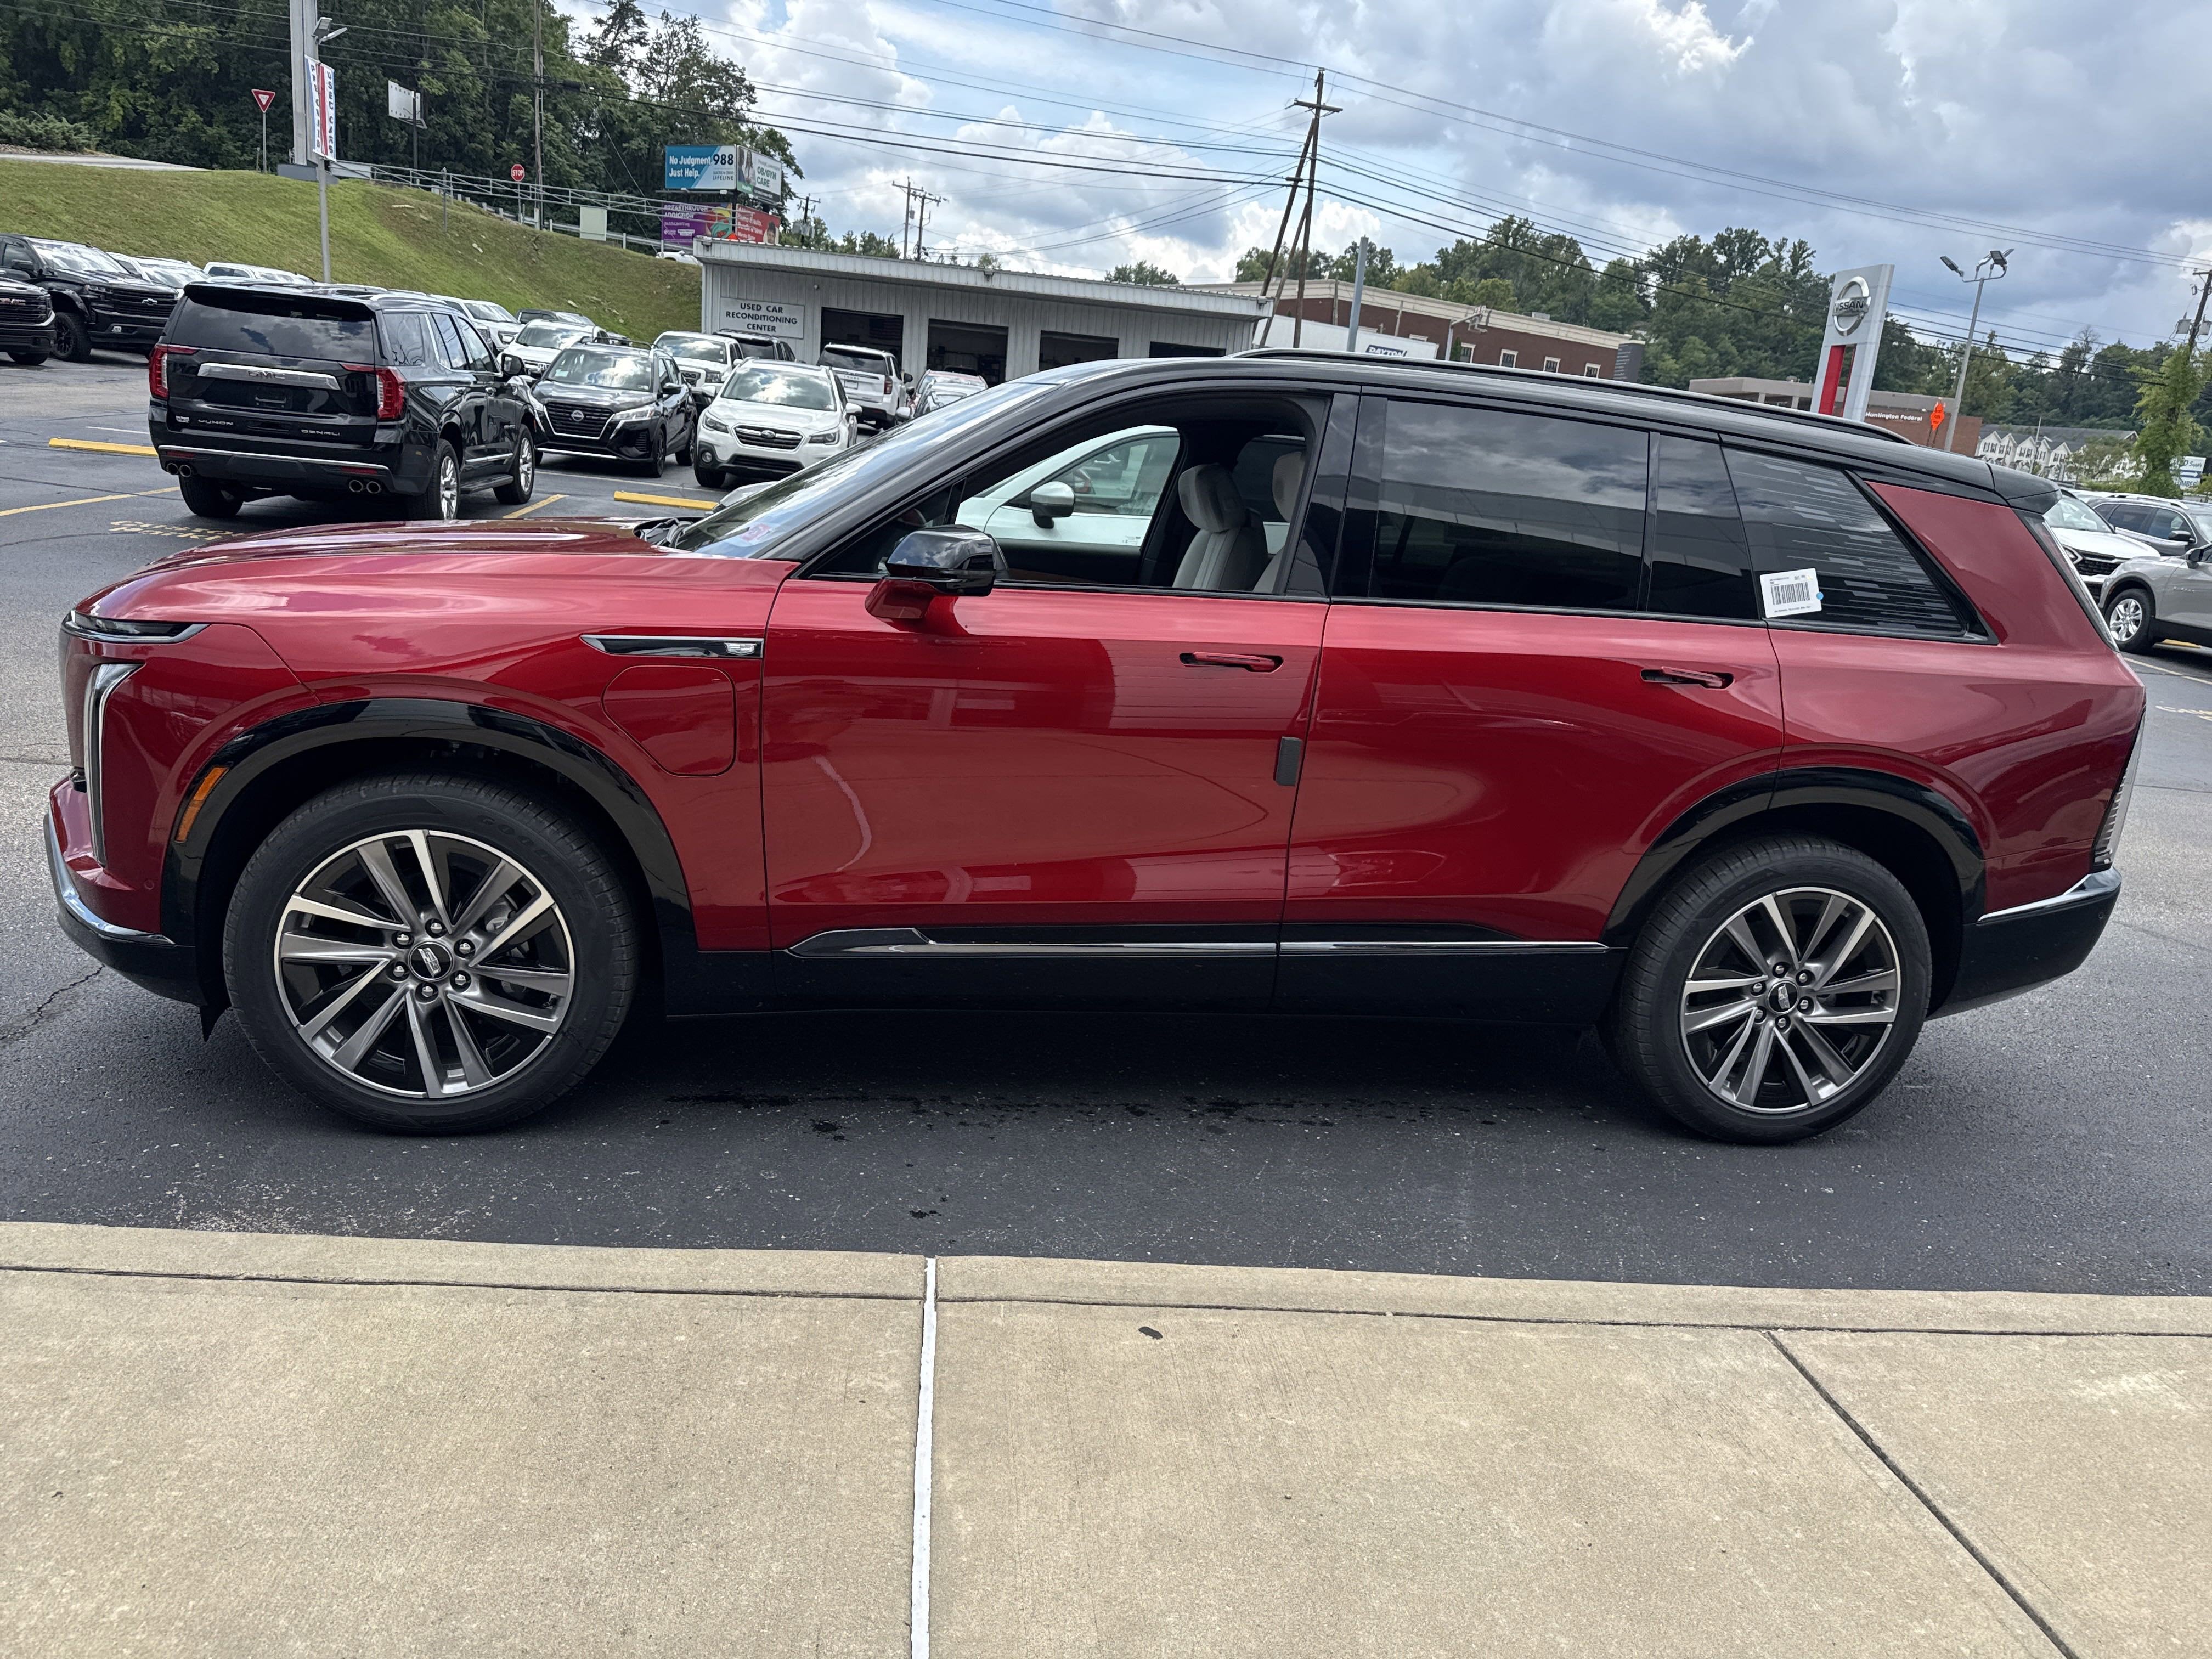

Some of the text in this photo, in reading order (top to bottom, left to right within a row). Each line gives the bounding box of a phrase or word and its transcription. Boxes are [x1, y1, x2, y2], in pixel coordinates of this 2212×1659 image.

[669, 156, 678, 165] No
[713, 154, 733, 165] 988
[669, 168, 700, 179] Just Help.
[757, 166, 776, 180] OB/GYN
[757, 176, 770, 187] CARE
[741, 303, 761, 311] USED
[726, 311, 797, 324] RECONDITIONING
[747, 323, 776, 332] CENTER
[247, 370, 286, 379] GMC
